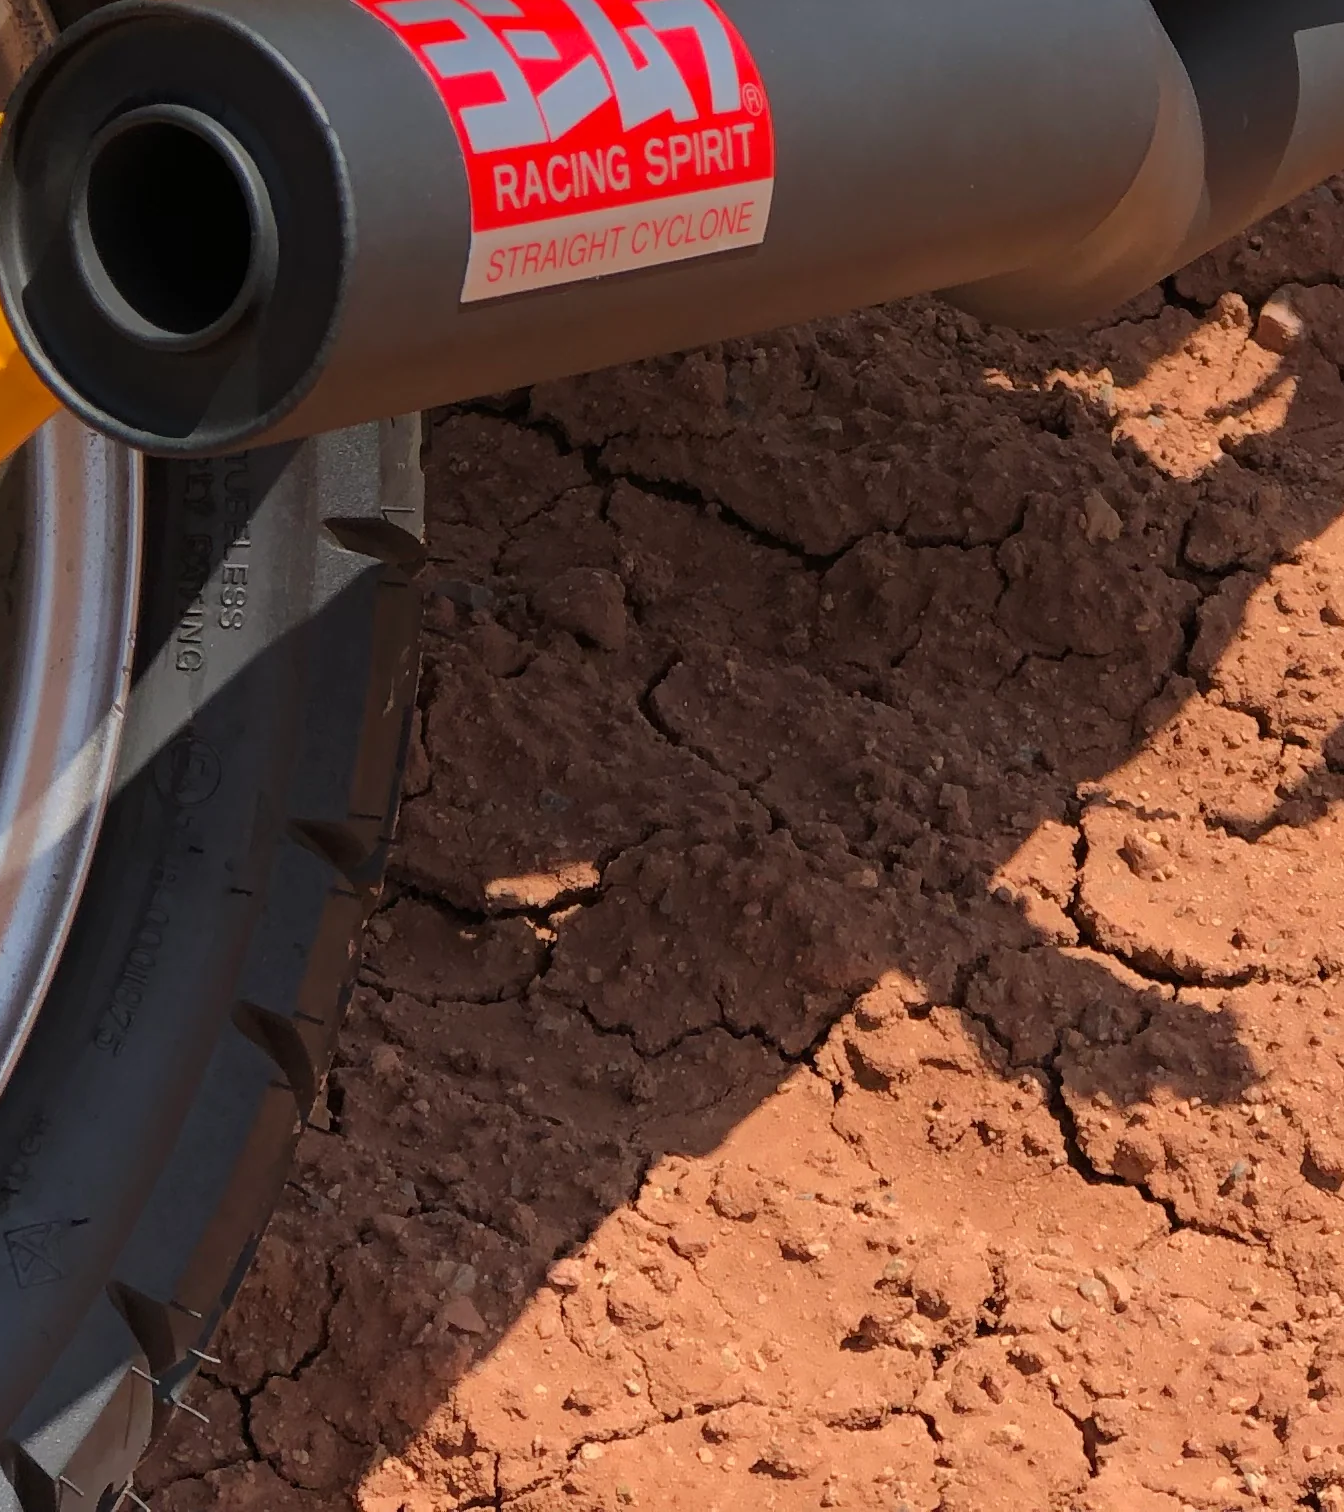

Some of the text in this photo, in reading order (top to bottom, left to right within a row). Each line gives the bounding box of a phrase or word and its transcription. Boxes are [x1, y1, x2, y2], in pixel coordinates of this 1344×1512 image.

[493, 122, 755, 210] RACING SPIRIT
[486, 201, 756, 284] STRAIGHT CYCLONE
